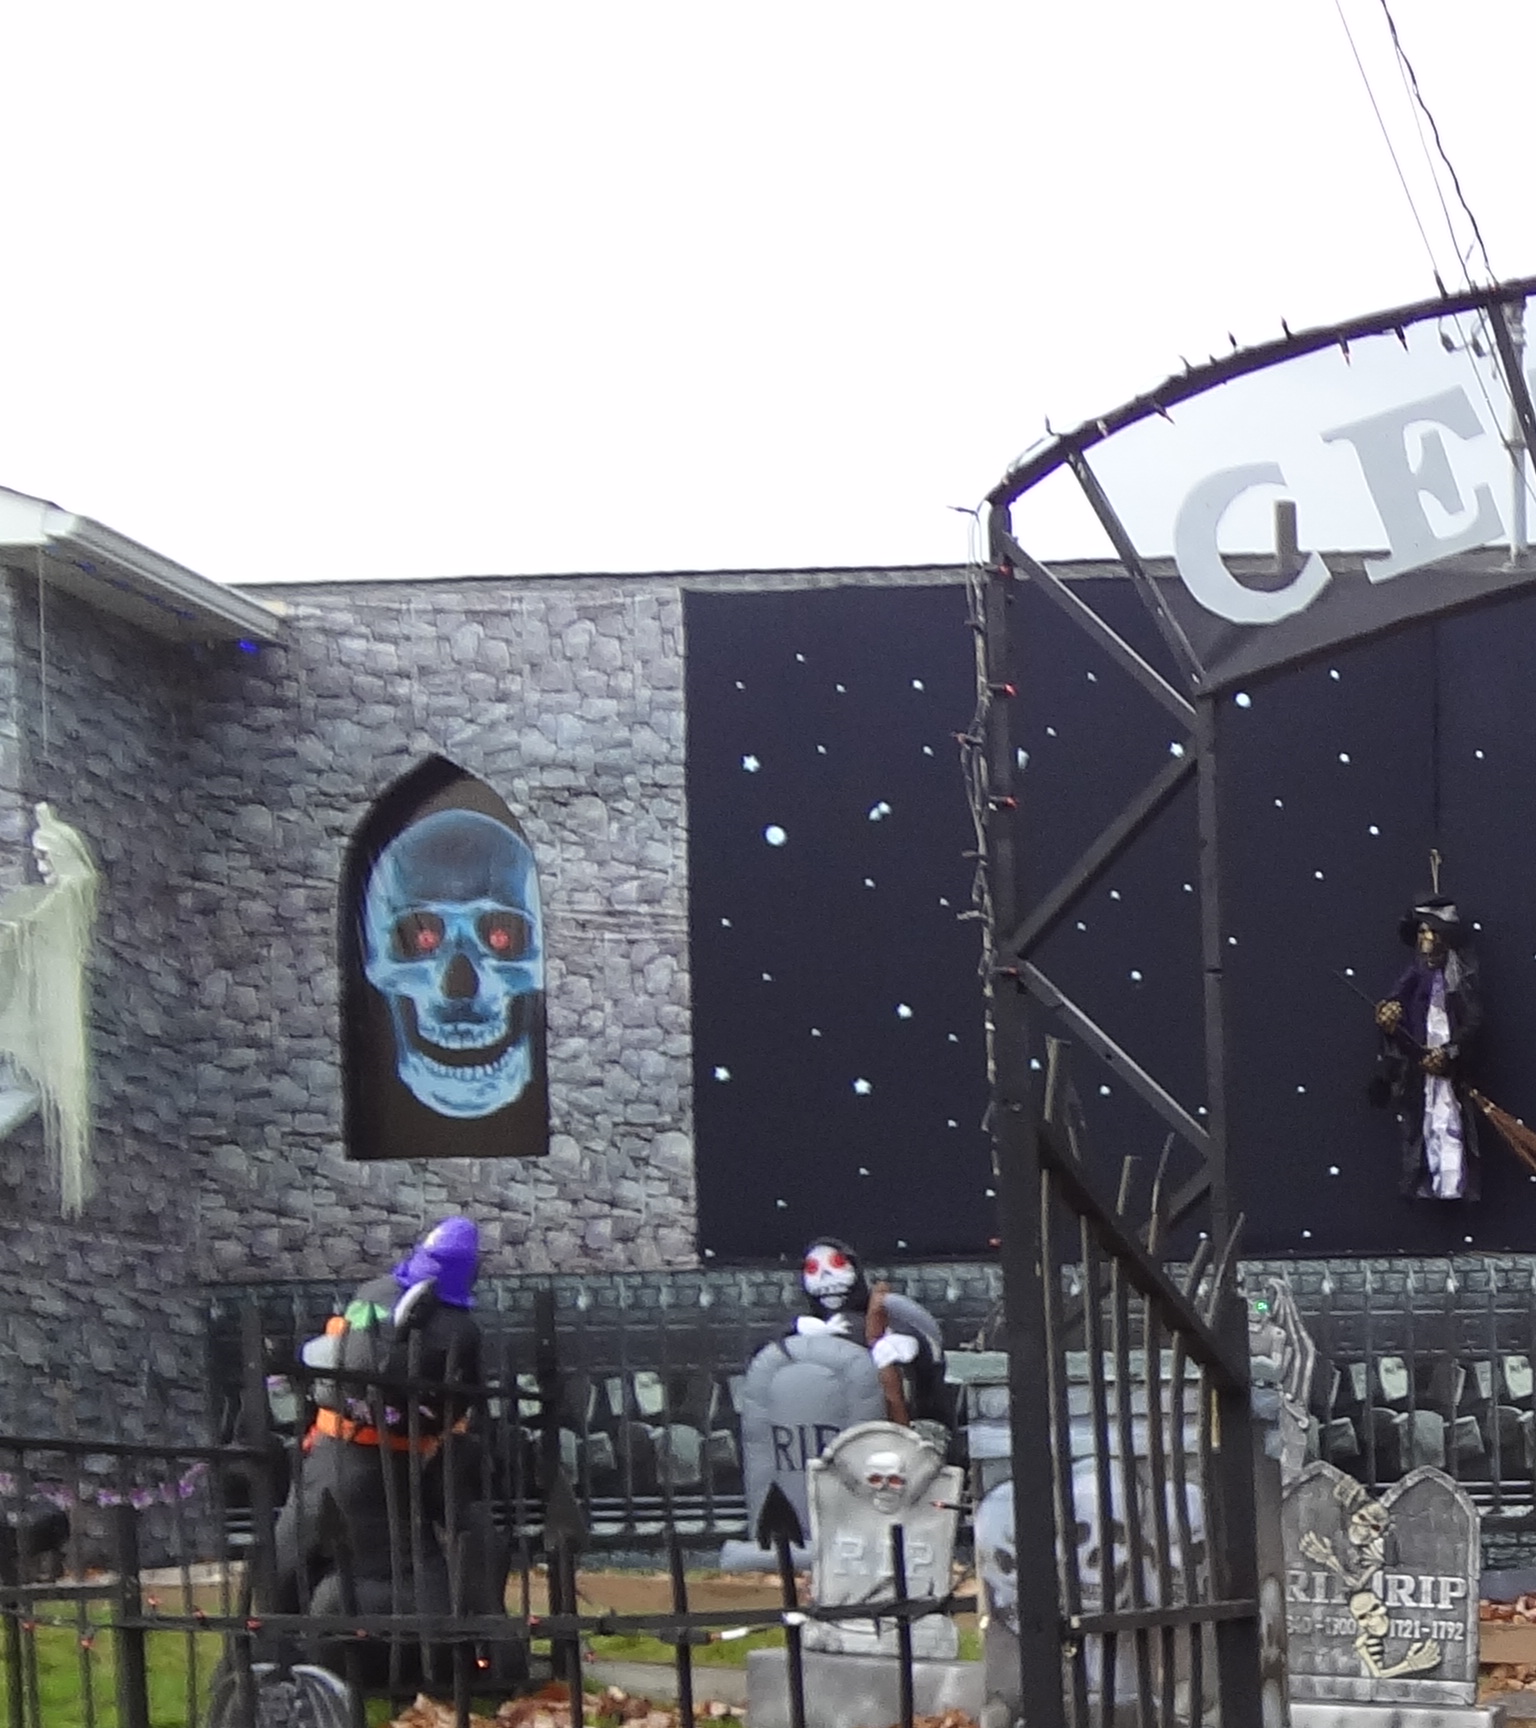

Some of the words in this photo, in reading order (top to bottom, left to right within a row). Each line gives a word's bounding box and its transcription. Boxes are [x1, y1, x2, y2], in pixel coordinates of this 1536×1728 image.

[833, 1534, 934, 1579] RIP
[1384, 1574, 1468, 1610] RIP
[1389, 1618, 1465, 1641] 1721-1792
